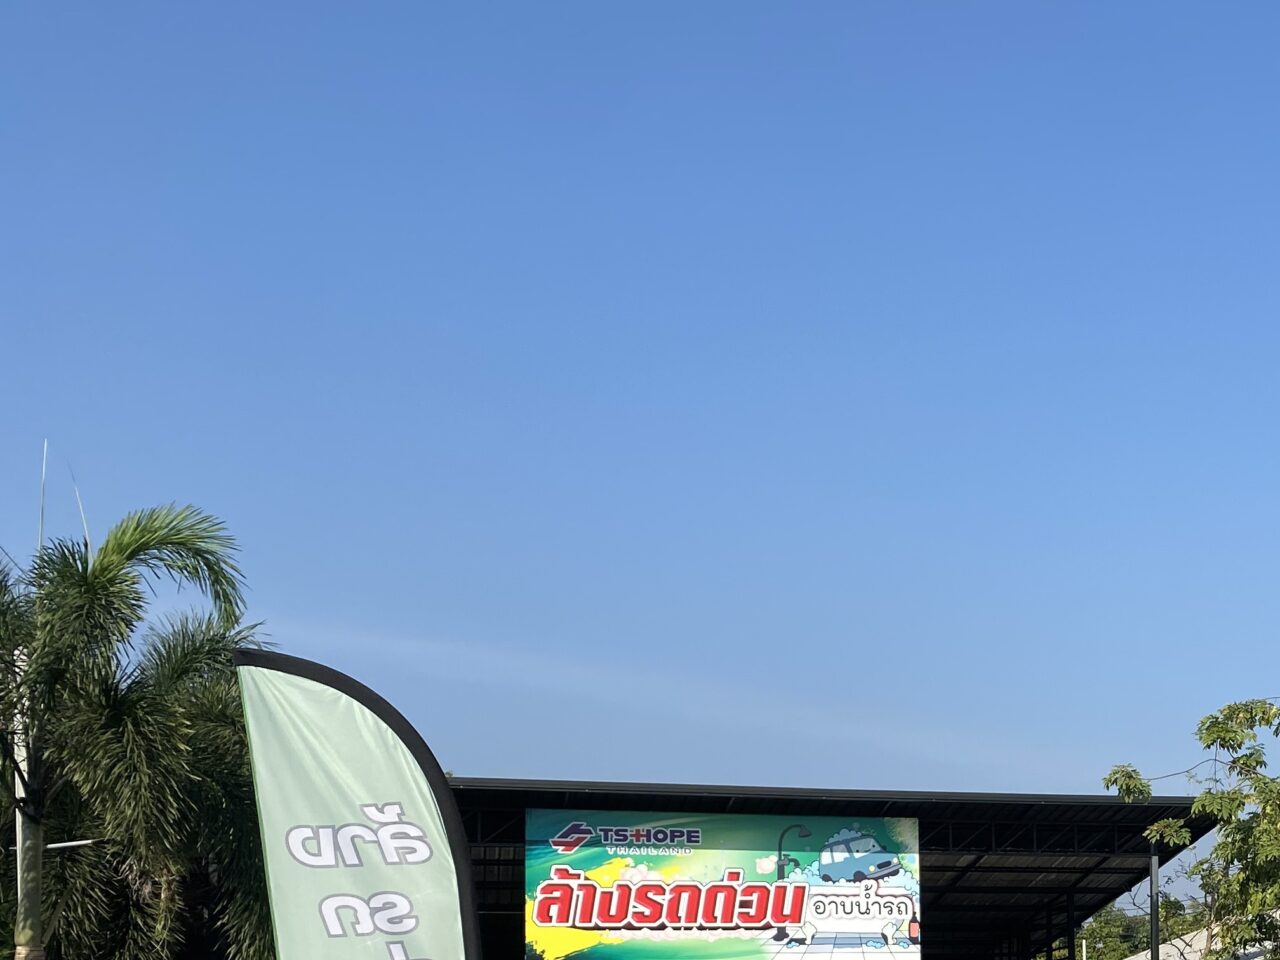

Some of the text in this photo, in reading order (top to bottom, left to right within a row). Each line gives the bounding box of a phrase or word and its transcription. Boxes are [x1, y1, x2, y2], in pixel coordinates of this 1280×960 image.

[606, 846, 694, 856] THAILAND
[534, 865, 808, 926] ล้างรถด่วน
[812, 883, 909, 916] อาบน้ำรถ
